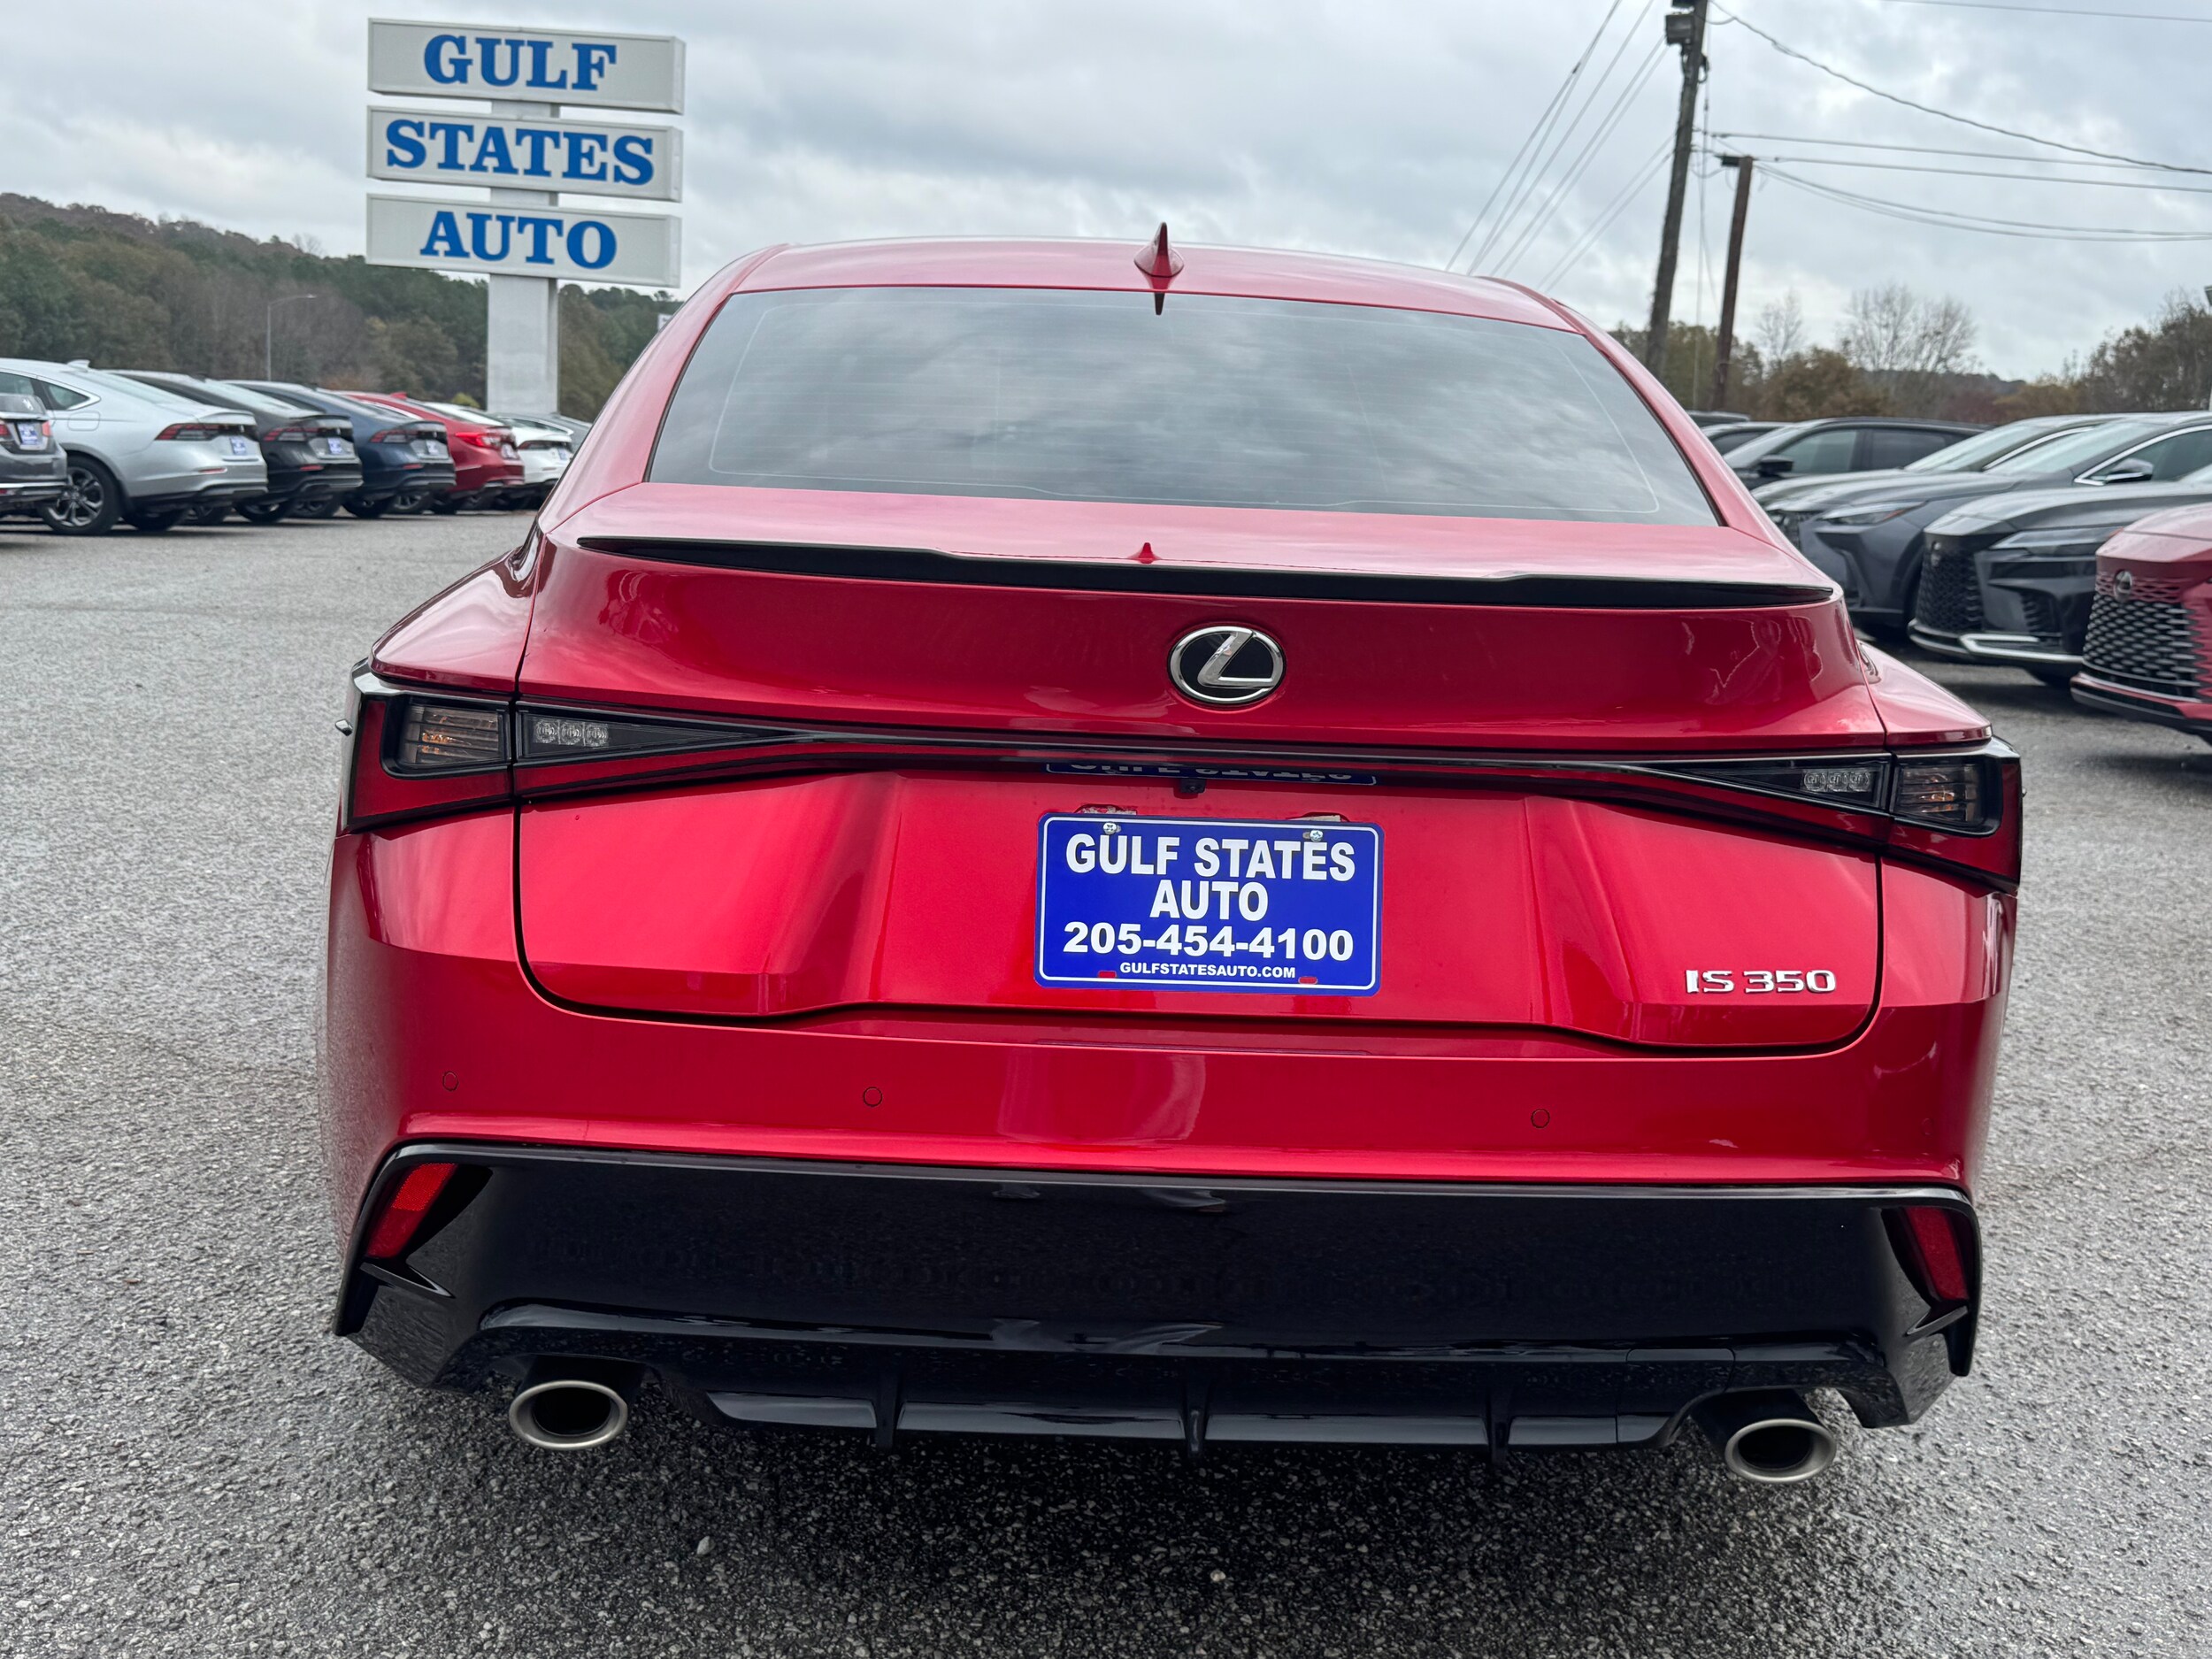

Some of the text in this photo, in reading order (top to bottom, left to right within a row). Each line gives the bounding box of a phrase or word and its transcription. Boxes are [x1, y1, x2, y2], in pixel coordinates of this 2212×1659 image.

[424, 34, 617, 91] GULF
[386, 119, 655, 186] STATES
[419, 211, 618, 270] AUTO
[1065, 833, 1356, 881] GULF STATES
[1149, 879, 1269, 921] AUTO
[1063, 921, 1354, 961] 205-454-4100
[1119, 962, 1296, 979] GULFSTATESAUTO.COM
[1685, 969, 1837, 994] IS 350
